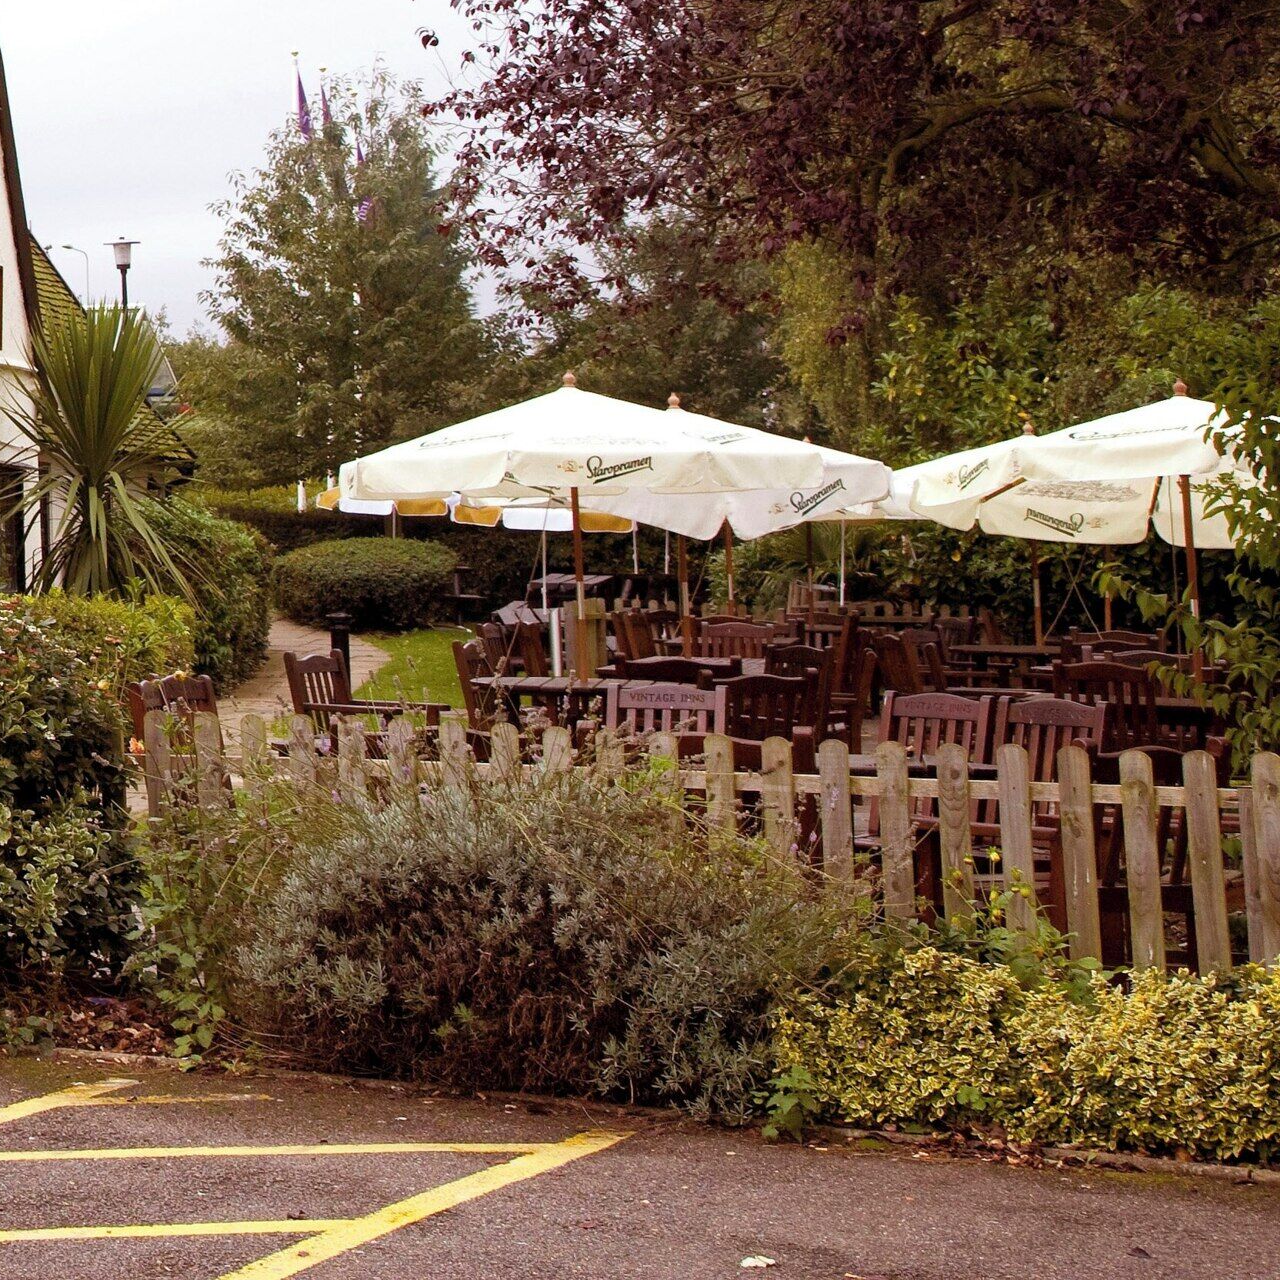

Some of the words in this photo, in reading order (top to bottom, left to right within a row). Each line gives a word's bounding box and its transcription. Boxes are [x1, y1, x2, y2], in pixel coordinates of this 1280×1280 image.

[586, 455, 653, 483] Staropramen
[790, 478, 847, 516] Staropramen
[629, 693, 675, 702] VINTAGE
[680, 693, 705, 703] INNS
